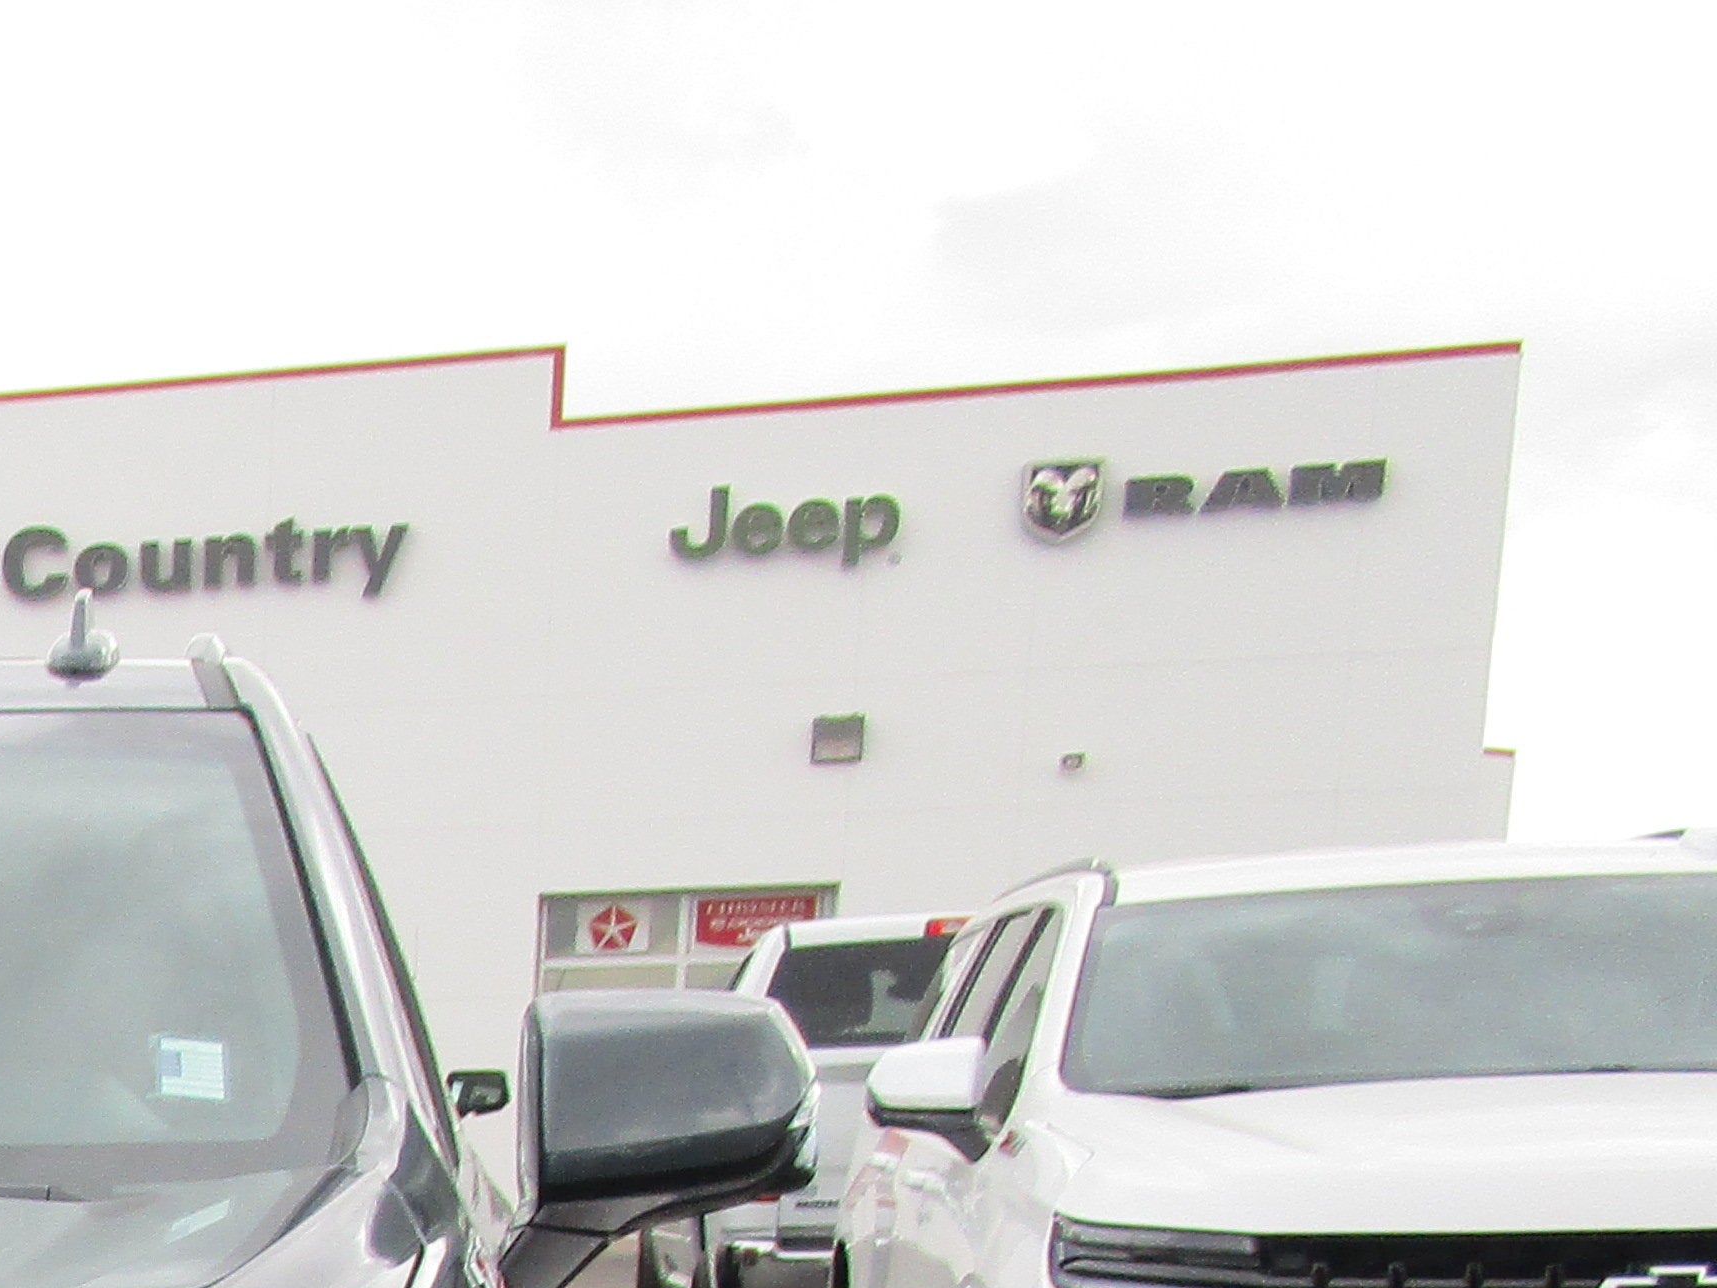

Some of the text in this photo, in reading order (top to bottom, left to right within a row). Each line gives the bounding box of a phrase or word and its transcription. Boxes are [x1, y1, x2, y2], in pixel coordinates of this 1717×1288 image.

[668, 484, 902, 567] Jeep
[1123, 458, 1389, 521] RAM
[2, 517, 409, 601] Country
